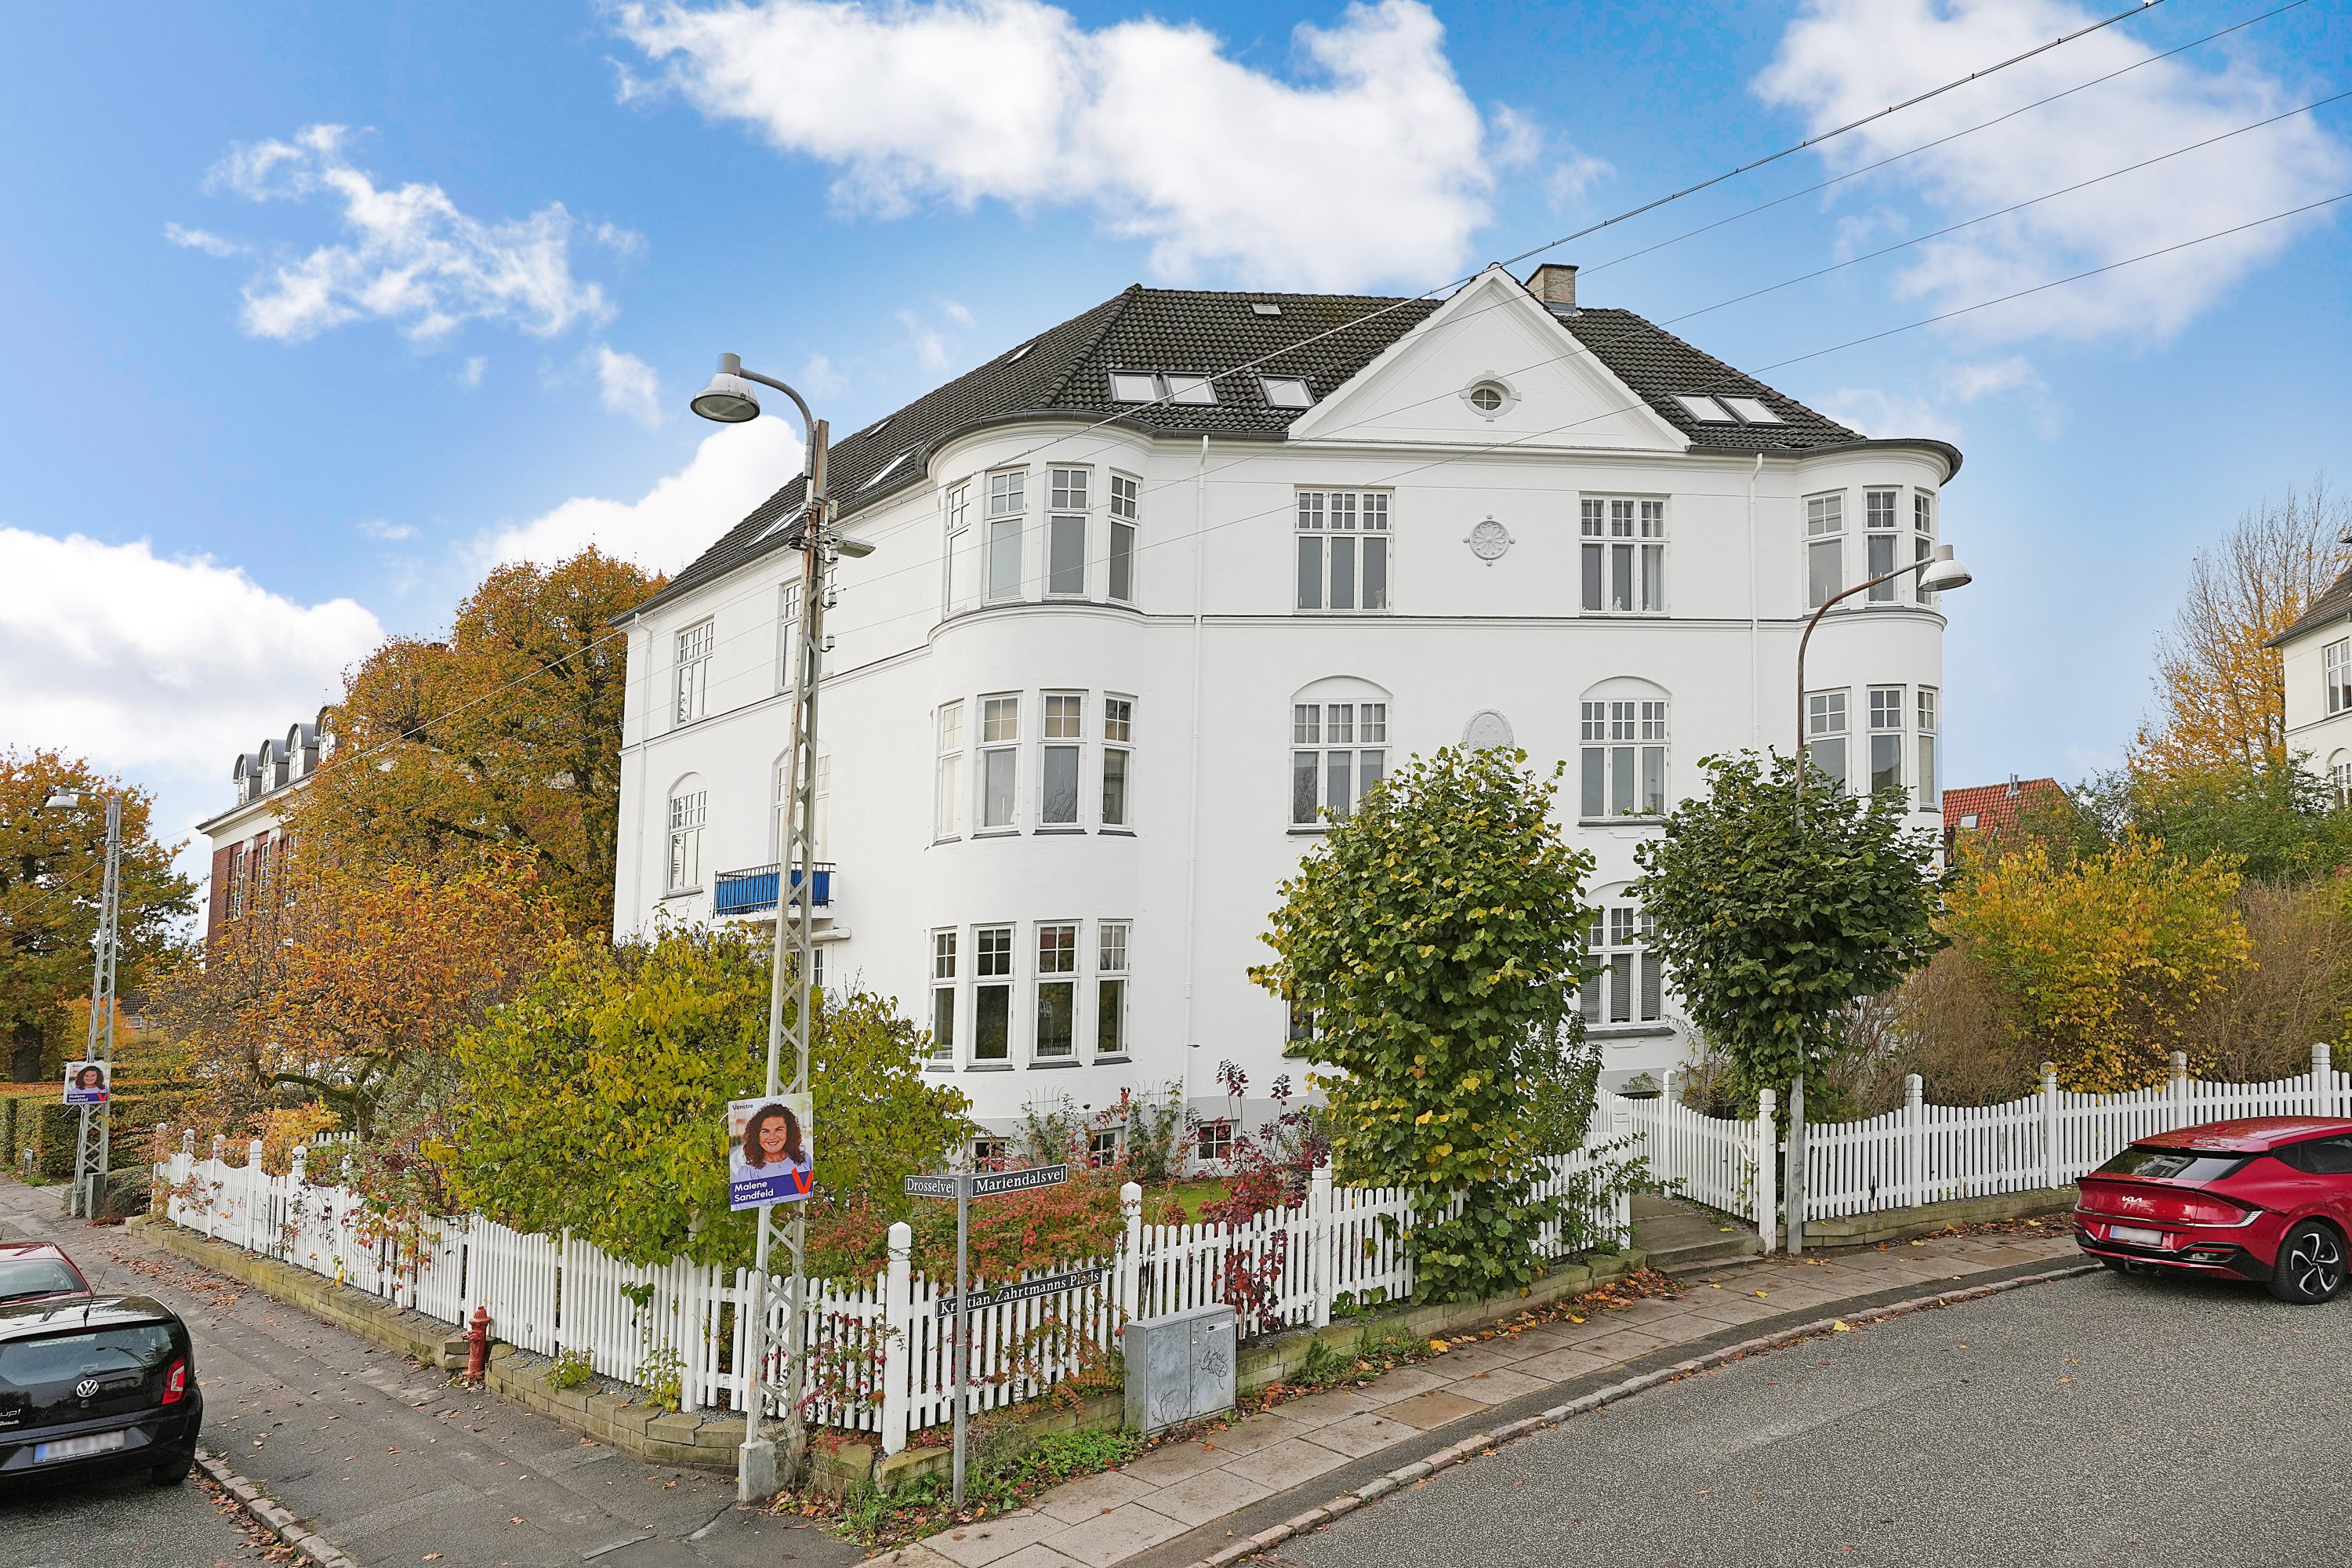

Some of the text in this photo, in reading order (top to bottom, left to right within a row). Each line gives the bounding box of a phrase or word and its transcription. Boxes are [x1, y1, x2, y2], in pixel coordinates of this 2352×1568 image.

[97, 1091, 109, 1102] V
[734, 1181, 768, 1192] Malene
[791, 1167, 814, 1195] V
[906, 1178, 955, 1196] Drosselvej
[975, 1168, 1065, 1193] Mariendalsvej
[734, 1188, 774, 1203] Sandfeld
[940, 1271, 1099, 1314] Krtian Zahrtmanns Plads
[0, 1408, 21, 1417] up!
